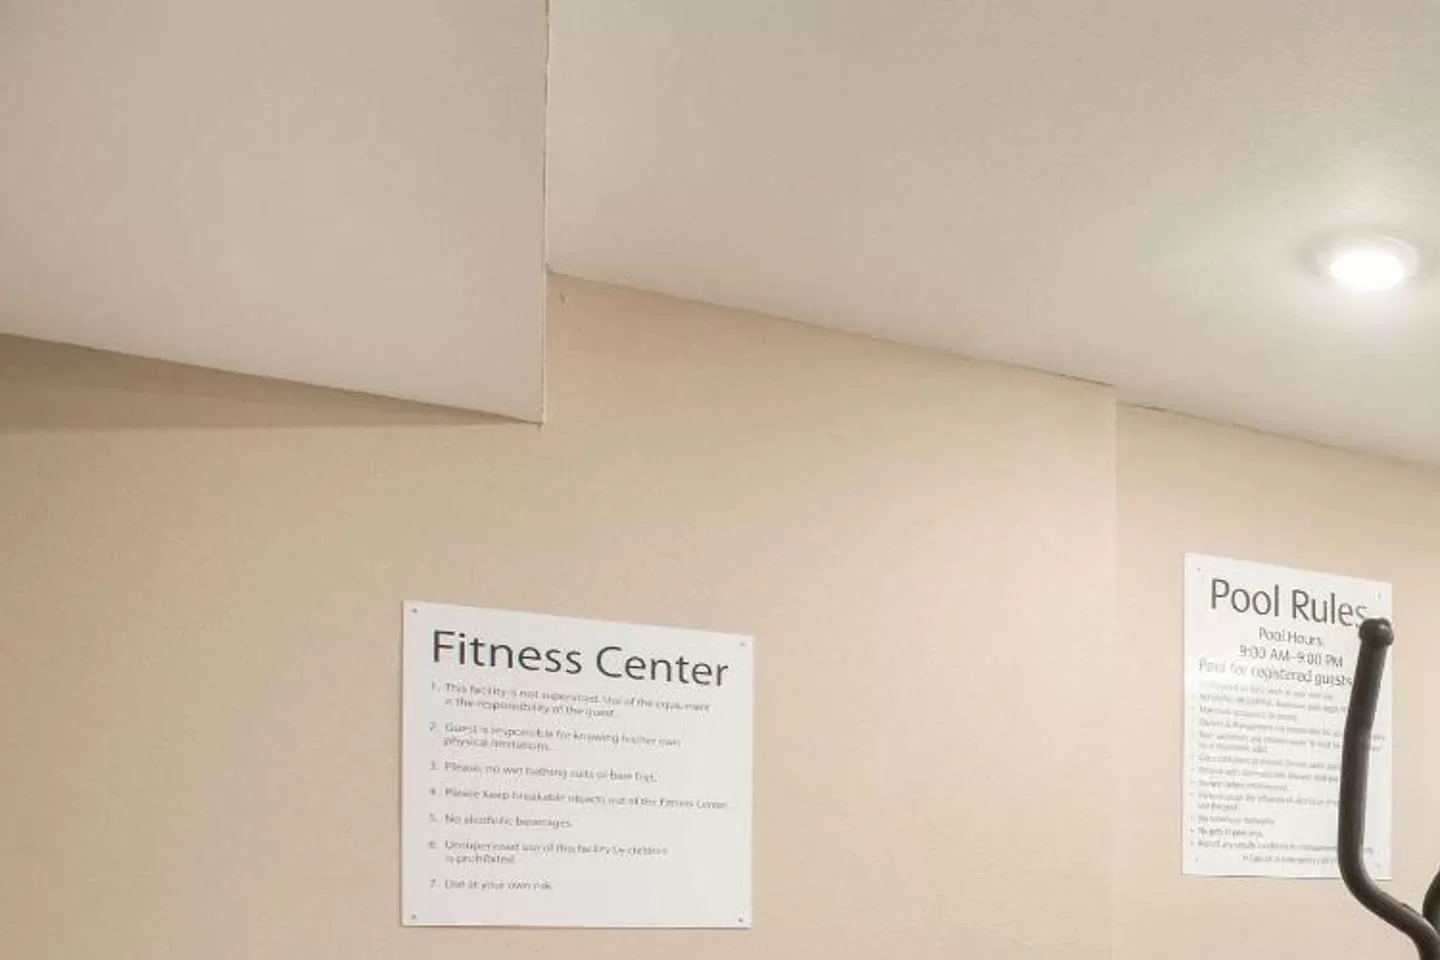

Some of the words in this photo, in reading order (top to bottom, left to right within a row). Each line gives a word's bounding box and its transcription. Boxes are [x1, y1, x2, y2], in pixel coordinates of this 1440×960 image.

[1210, 578, 1281, 618] Pool
[1291, 588, 1369, 628] Rules
[1258, 627, 1286, 642] Pool
[432, 629, 583, 675] Fitness
[595, 646, 730, 687] Center
[1239, 644, 1267, 660] 9:00
[1326, 654, 1344, 668] PM
[1198, 658, 1227, 674] Pool
[1230, 662, 1248, 677] for
[1251, 664, 1313, 683] registered
